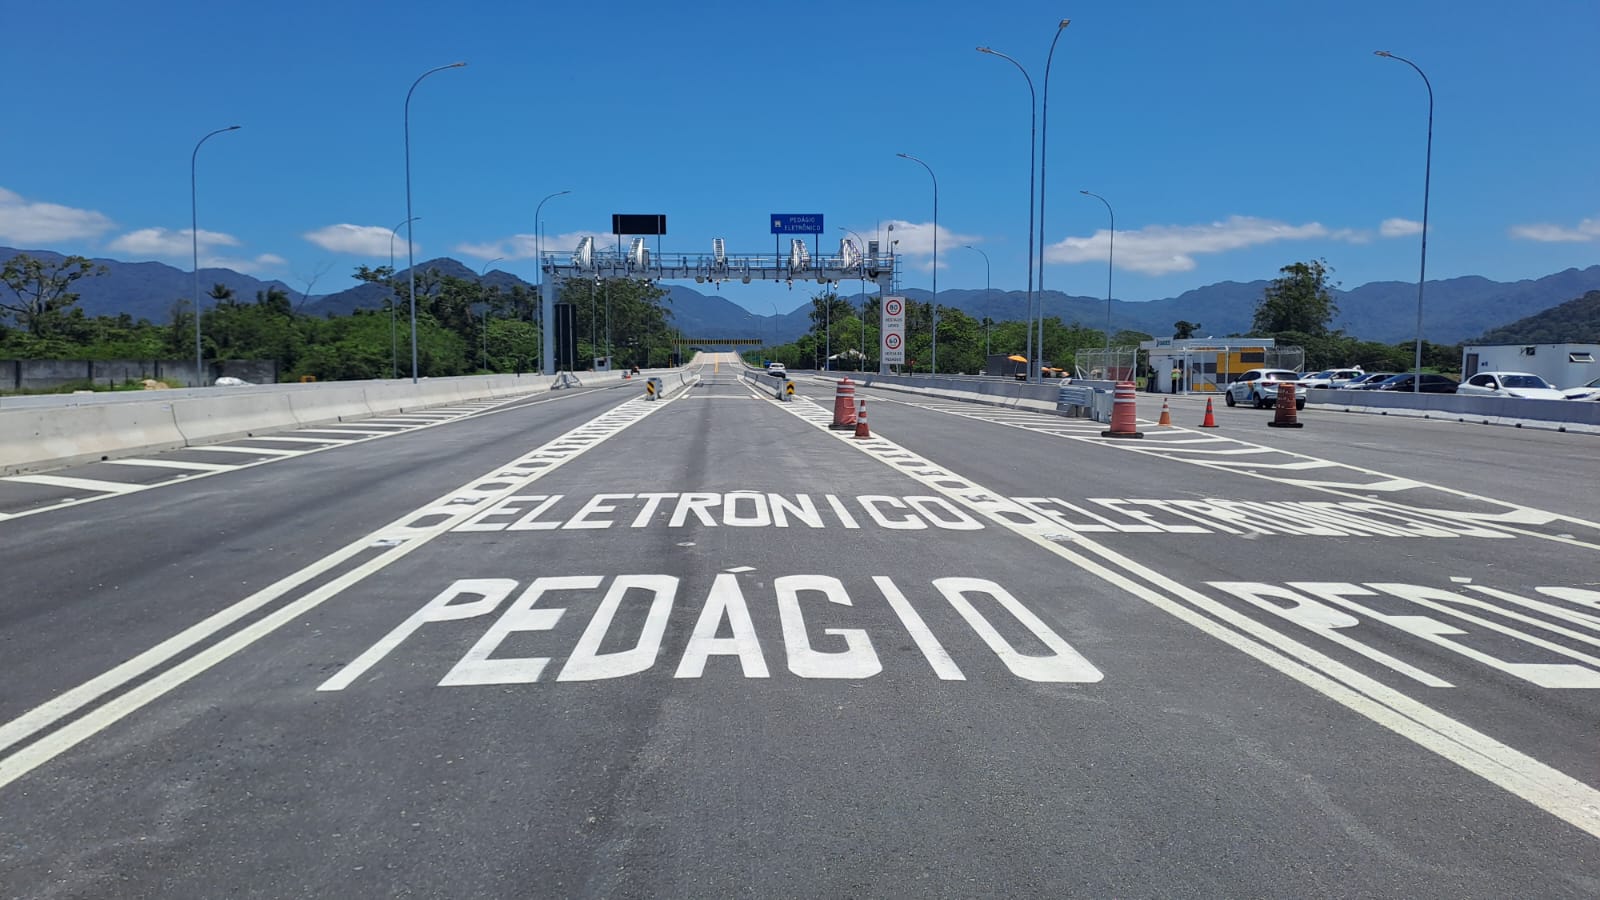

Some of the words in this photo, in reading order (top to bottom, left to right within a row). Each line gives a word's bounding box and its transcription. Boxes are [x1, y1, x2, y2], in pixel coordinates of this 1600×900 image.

[784, 223, 821, 231] ELETRÔNICO
[789, 216, 816, 224] PEDÁGIO
[448, 489, 986, 531] ELETRÔNICO
[316, 566, 1105, 692] PEDÁGIO
